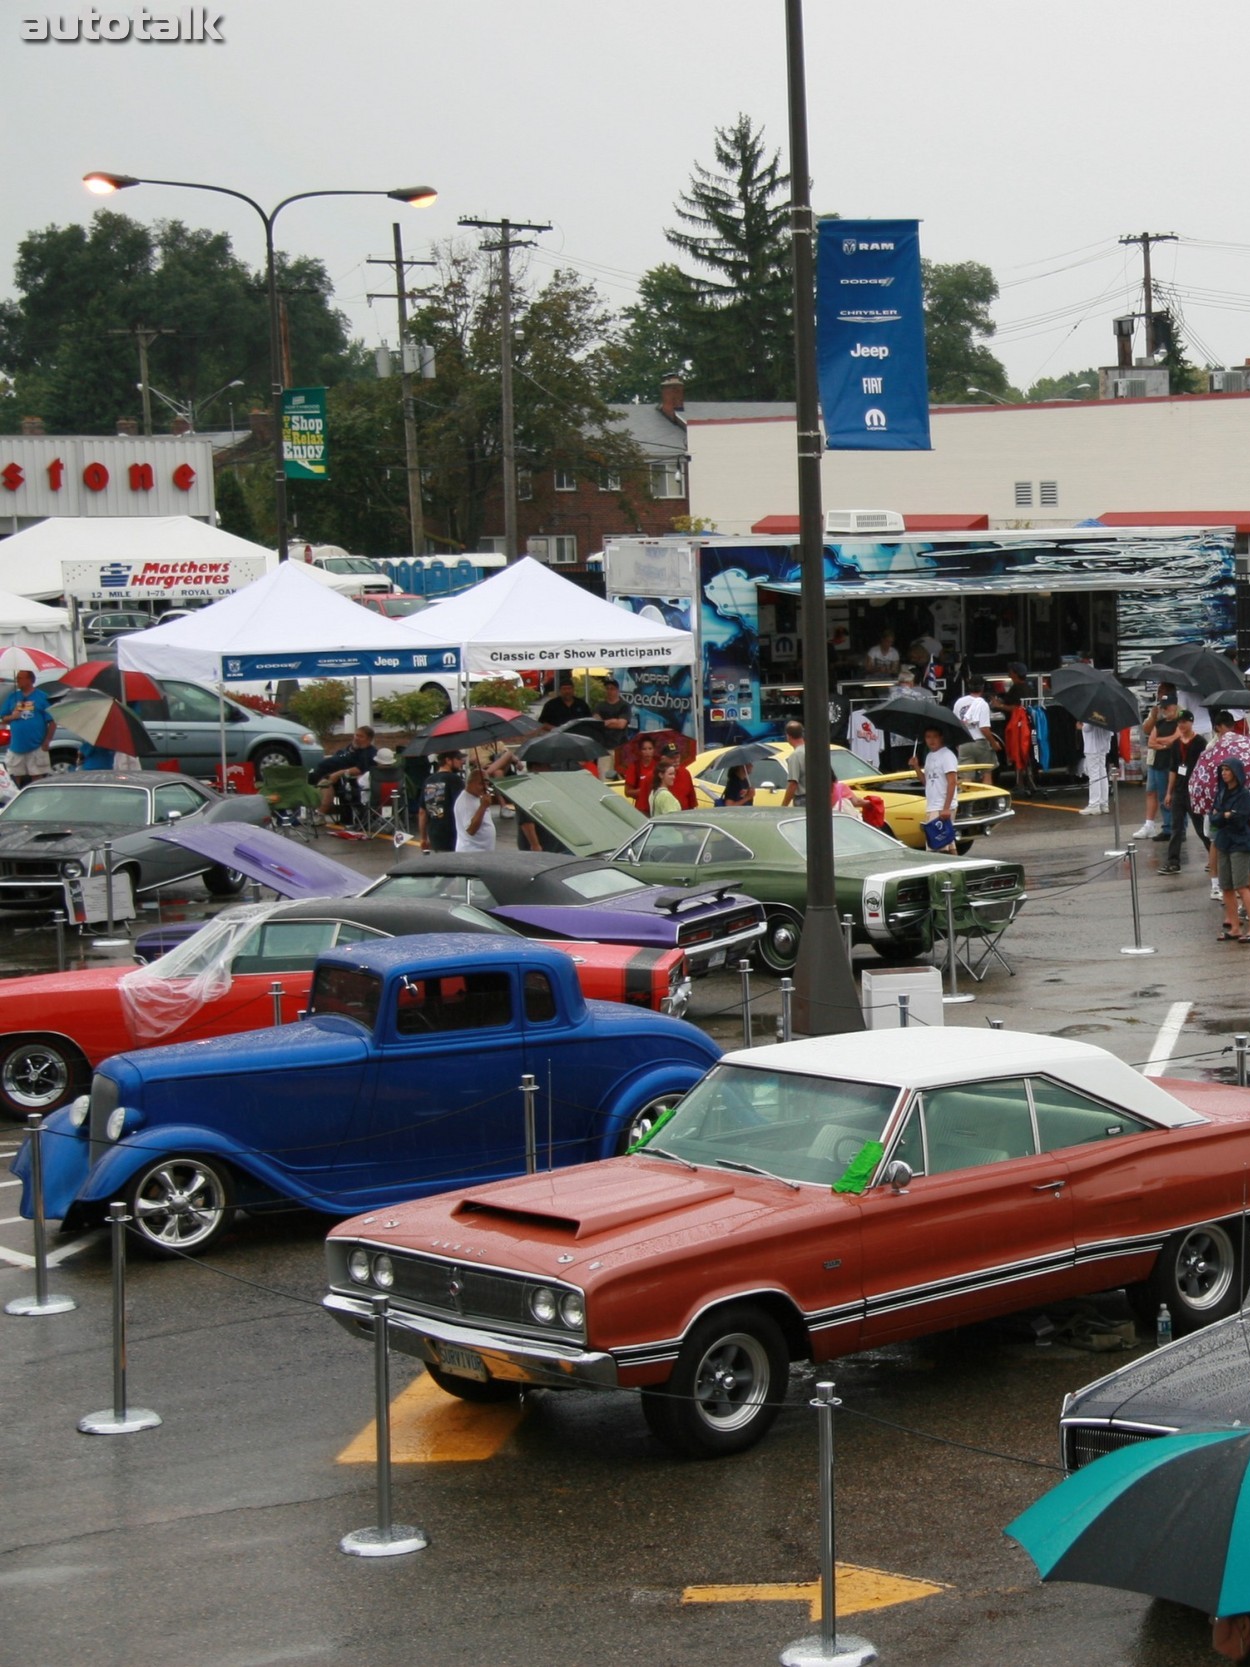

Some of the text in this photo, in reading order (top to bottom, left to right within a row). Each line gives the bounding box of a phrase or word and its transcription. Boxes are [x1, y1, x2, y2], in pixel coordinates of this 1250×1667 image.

[858, 242, 895, 251] RAM
[850, 343, 889, 360] Jeep
[862, 377, 883, 394] FIAT
[291, 415, 323, 434] Shop
[291, 431, 324, 445] Relax
[282, 441, 325, 459] Enjoy
[142, 561, 230, 574] Matthews
[130, 573, 230, 589] Hargreaves
[181, 588, 212, 596] ROYAL
[412, 654, 428, 668] FIAT
[490, 646, 672, 662] Classic Car Show Participants
[374, 656, 400, 668] Jeep
[634, 672, 671, 685] MOPAR
